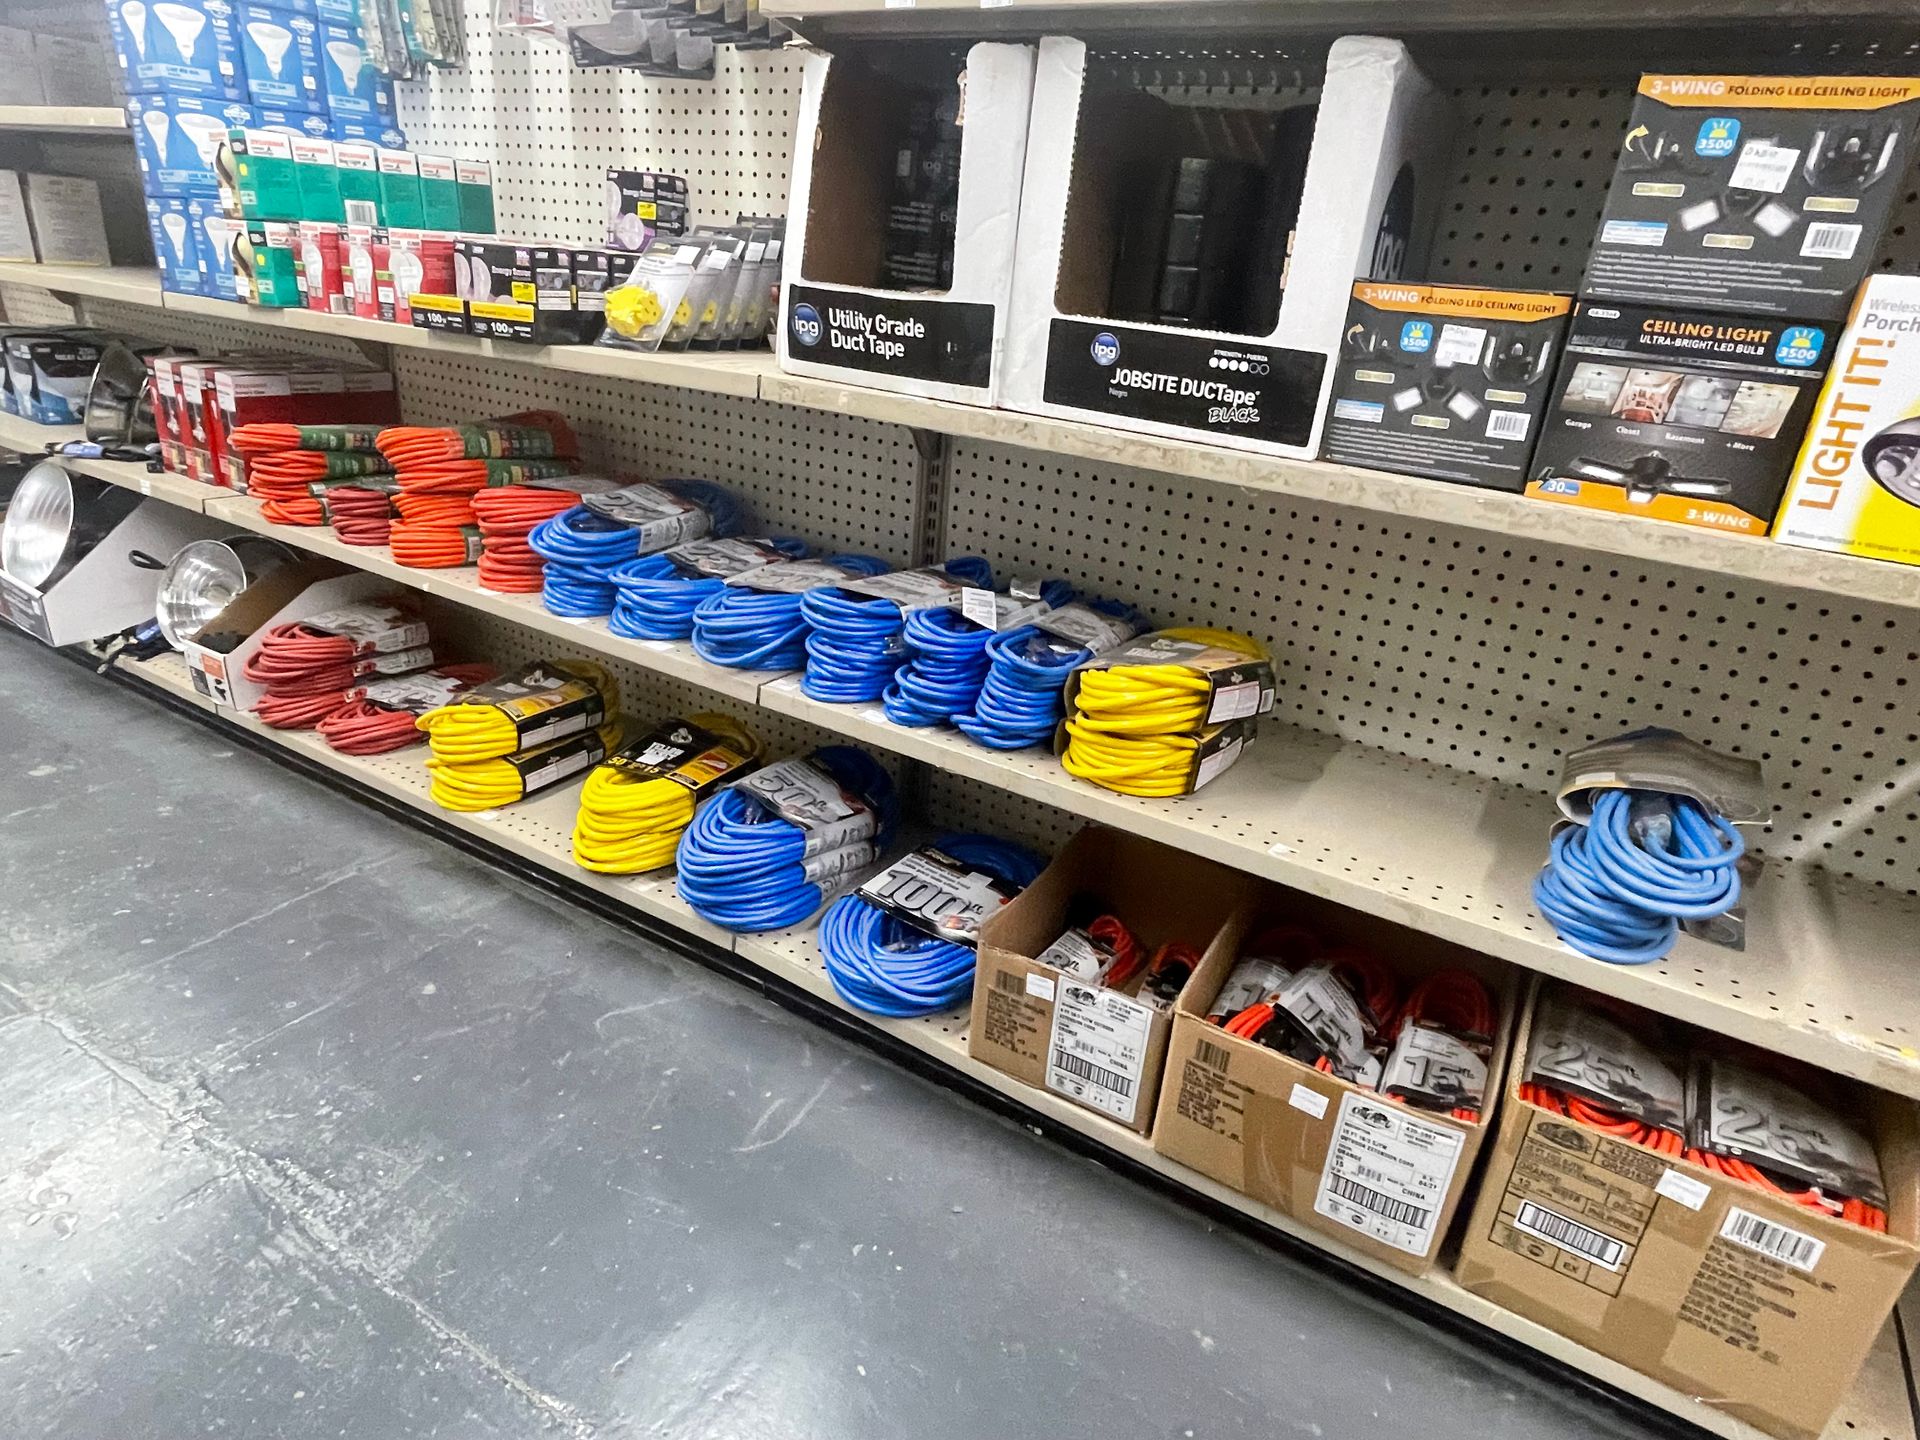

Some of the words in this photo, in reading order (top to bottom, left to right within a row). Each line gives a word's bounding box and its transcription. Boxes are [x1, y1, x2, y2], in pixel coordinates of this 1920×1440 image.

[1650, 80, 1725, 95] 3-WING
[1728, 85, 1785, 97] FOLDING
[1788, 86, 1811, 97] LED
[1814, 86, 1866, 98] CEILING
[1869, 86, 1911, 98] LIGHT
[1698, 138, 1733, 150] 3500
[1363, 290, 1418, 303] 3-WING
[1421, 296, 1463, 308] FOLDING
[1466, 299, 1483, 308] LED
[1485, 301, 1524, 312] CEILING
[1526, 304, 1557, 314] LIGHT
[1869, 299, 1920, 314] Wireles
[795, 316, 819, 336] ipg
[829, 307, 873, 338] Utility
[875, 314, 925, 339] Grade
[1643, 319, 1713, 338] CEILING
[1716, 326, 1772, 344] LIGHT
[1863, 313, 1920, 333] Porch
[830, 329, 866, 352] Duct
[866, 335, 905, 360] Tape
[1095, 341, 1117, 360] ipg
[1401, 337, 1429, 347] 3500
[1639, 334, 1713, 350] ULTRA-BRIGHT
[1714, 342, 1735, 353] LED
[1735, 343, 1765, 356] BULB
[1778, 346, 1817, 360] 3500
[1110, 367, 1179, 394] JOBSITE
[1208, 406, 1260, 423] BLACK
[1797, 392, 1872, 511] LIGHT
[1842, 336, 1896, 387] IT!
[1565, 418, 1592, 430] Garage
[1616, 425, 1641, 436] Closet
[1665, 432, 1705, 444] Basement
[1548, 480, 1566, 493] 30
[1685, 508, 1751, 529] 3-WING
[1401, 1186, 1425, 1201] CHINA
